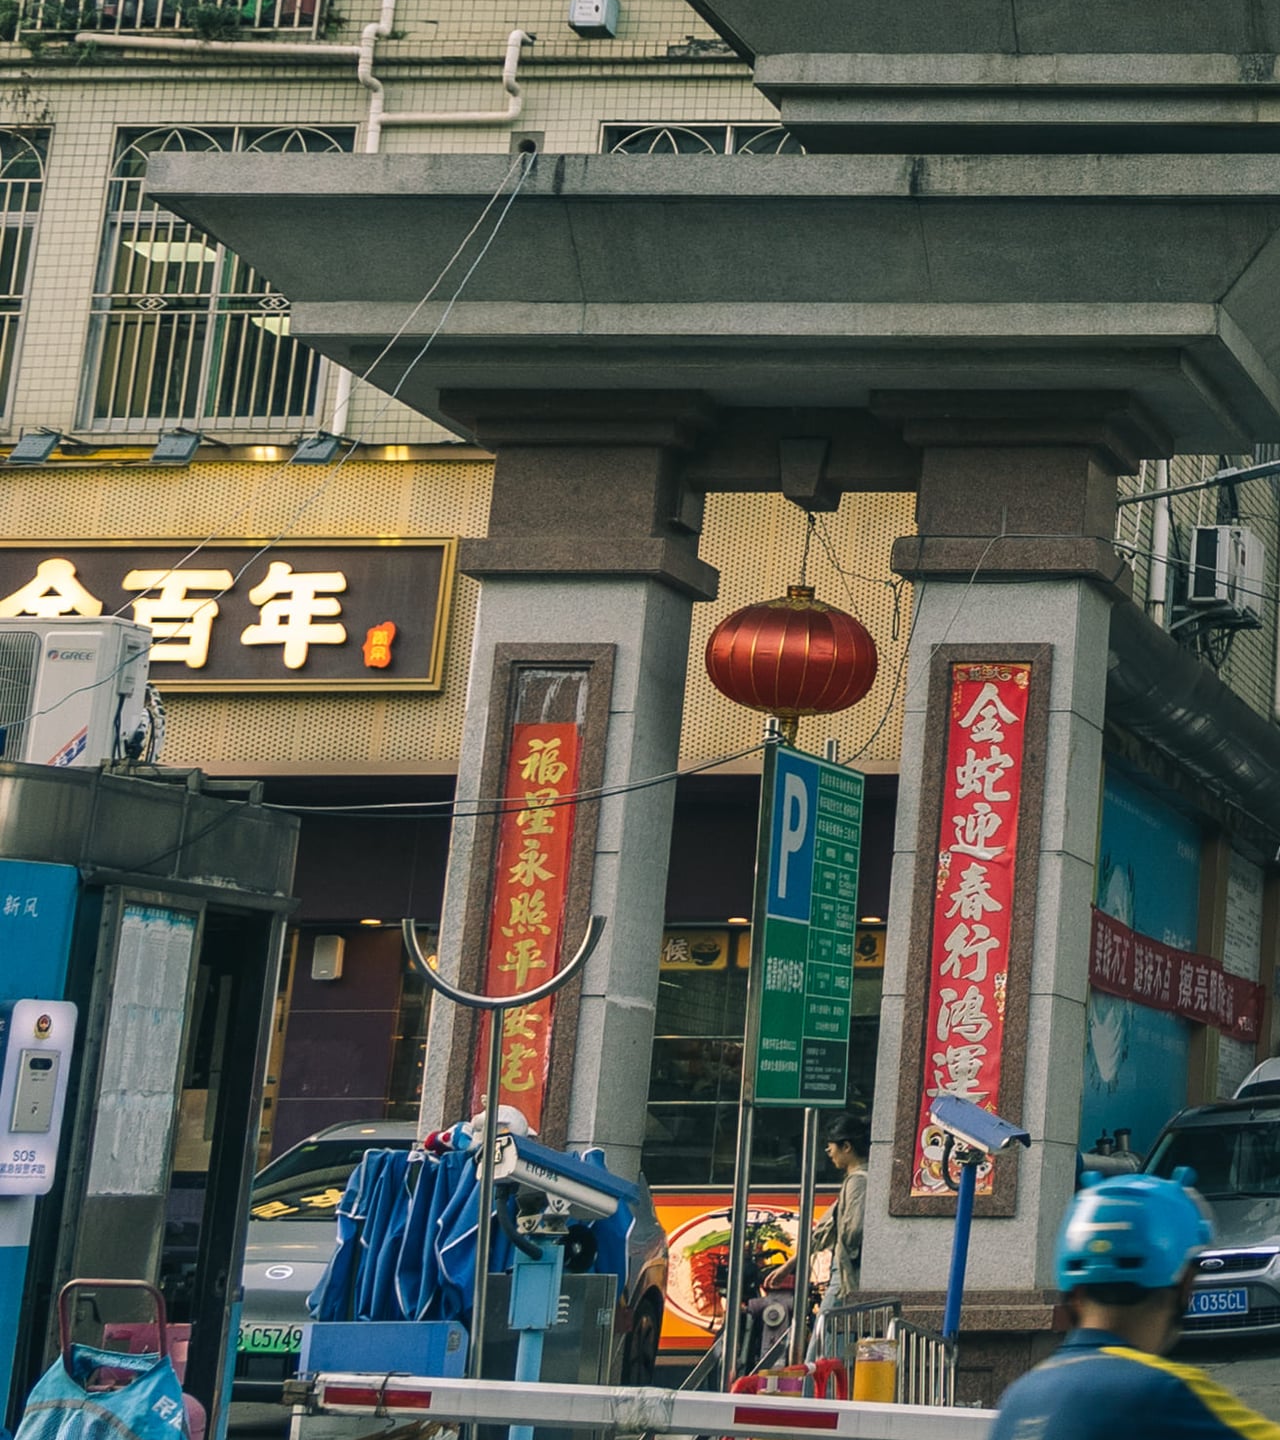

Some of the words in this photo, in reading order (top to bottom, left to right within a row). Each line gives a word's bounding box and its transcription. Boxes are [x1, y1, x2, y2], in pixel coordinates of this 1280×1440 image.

[60, 650, 96, 662] GREE
[778, 772, 808, 899] P
[2, 895, 39, 918] 新风
[12, 1150, 36, 1162] SOS
